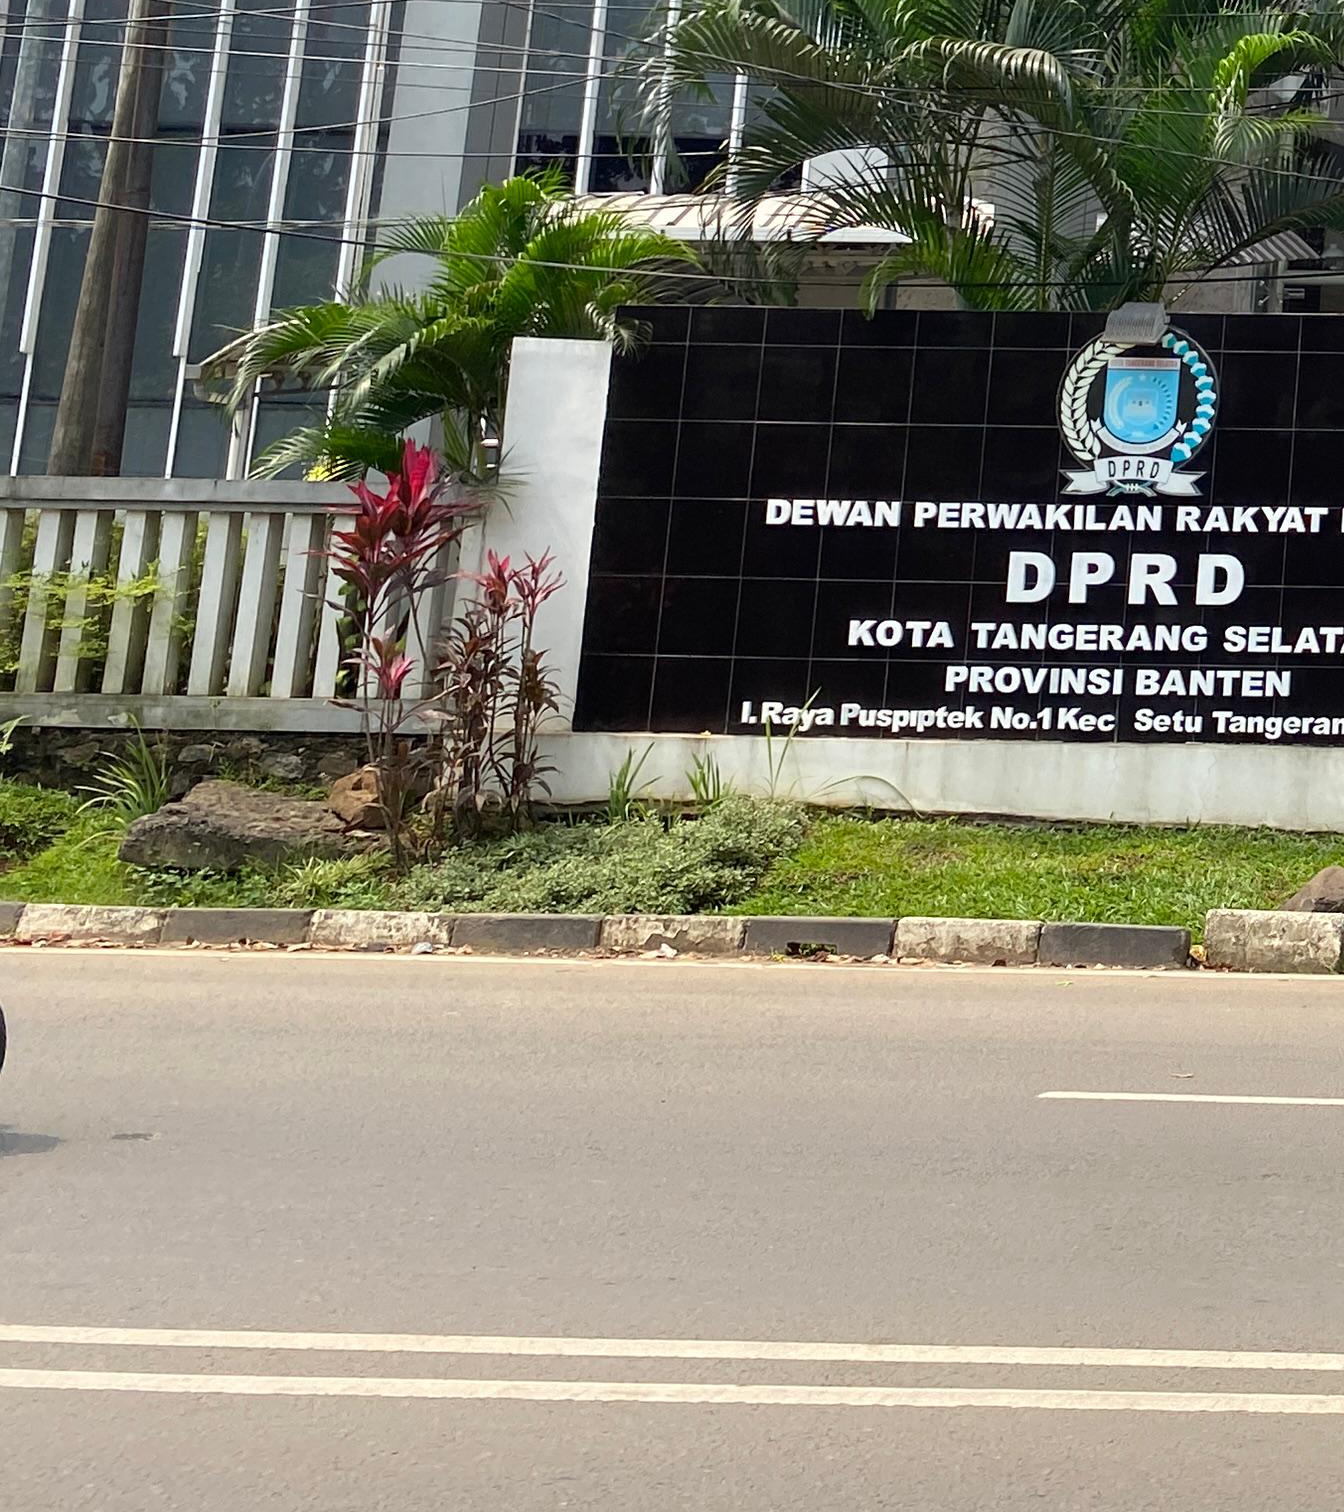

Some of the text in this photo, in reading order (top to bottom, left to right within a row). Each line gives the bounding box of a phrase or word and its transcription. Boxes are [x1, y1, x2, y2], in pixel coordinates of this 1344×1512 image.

[1108, 460, 1160, 479] DPRD
[766, 499, 901, 526] DEWAN
[914, 502, 1162, 530] PERWAKILAN
[1176, 506, 1328, 532] RAKYAT
[1006, 552, 1244, 605] DPRD
[848, 620, 954, 647] KOTA
[971, 623, 1207, 651] TANGERANG
[945, 666, 1290, 696] PROVINSI BANTEN
[1134, 709, 1202, 732] Setu
